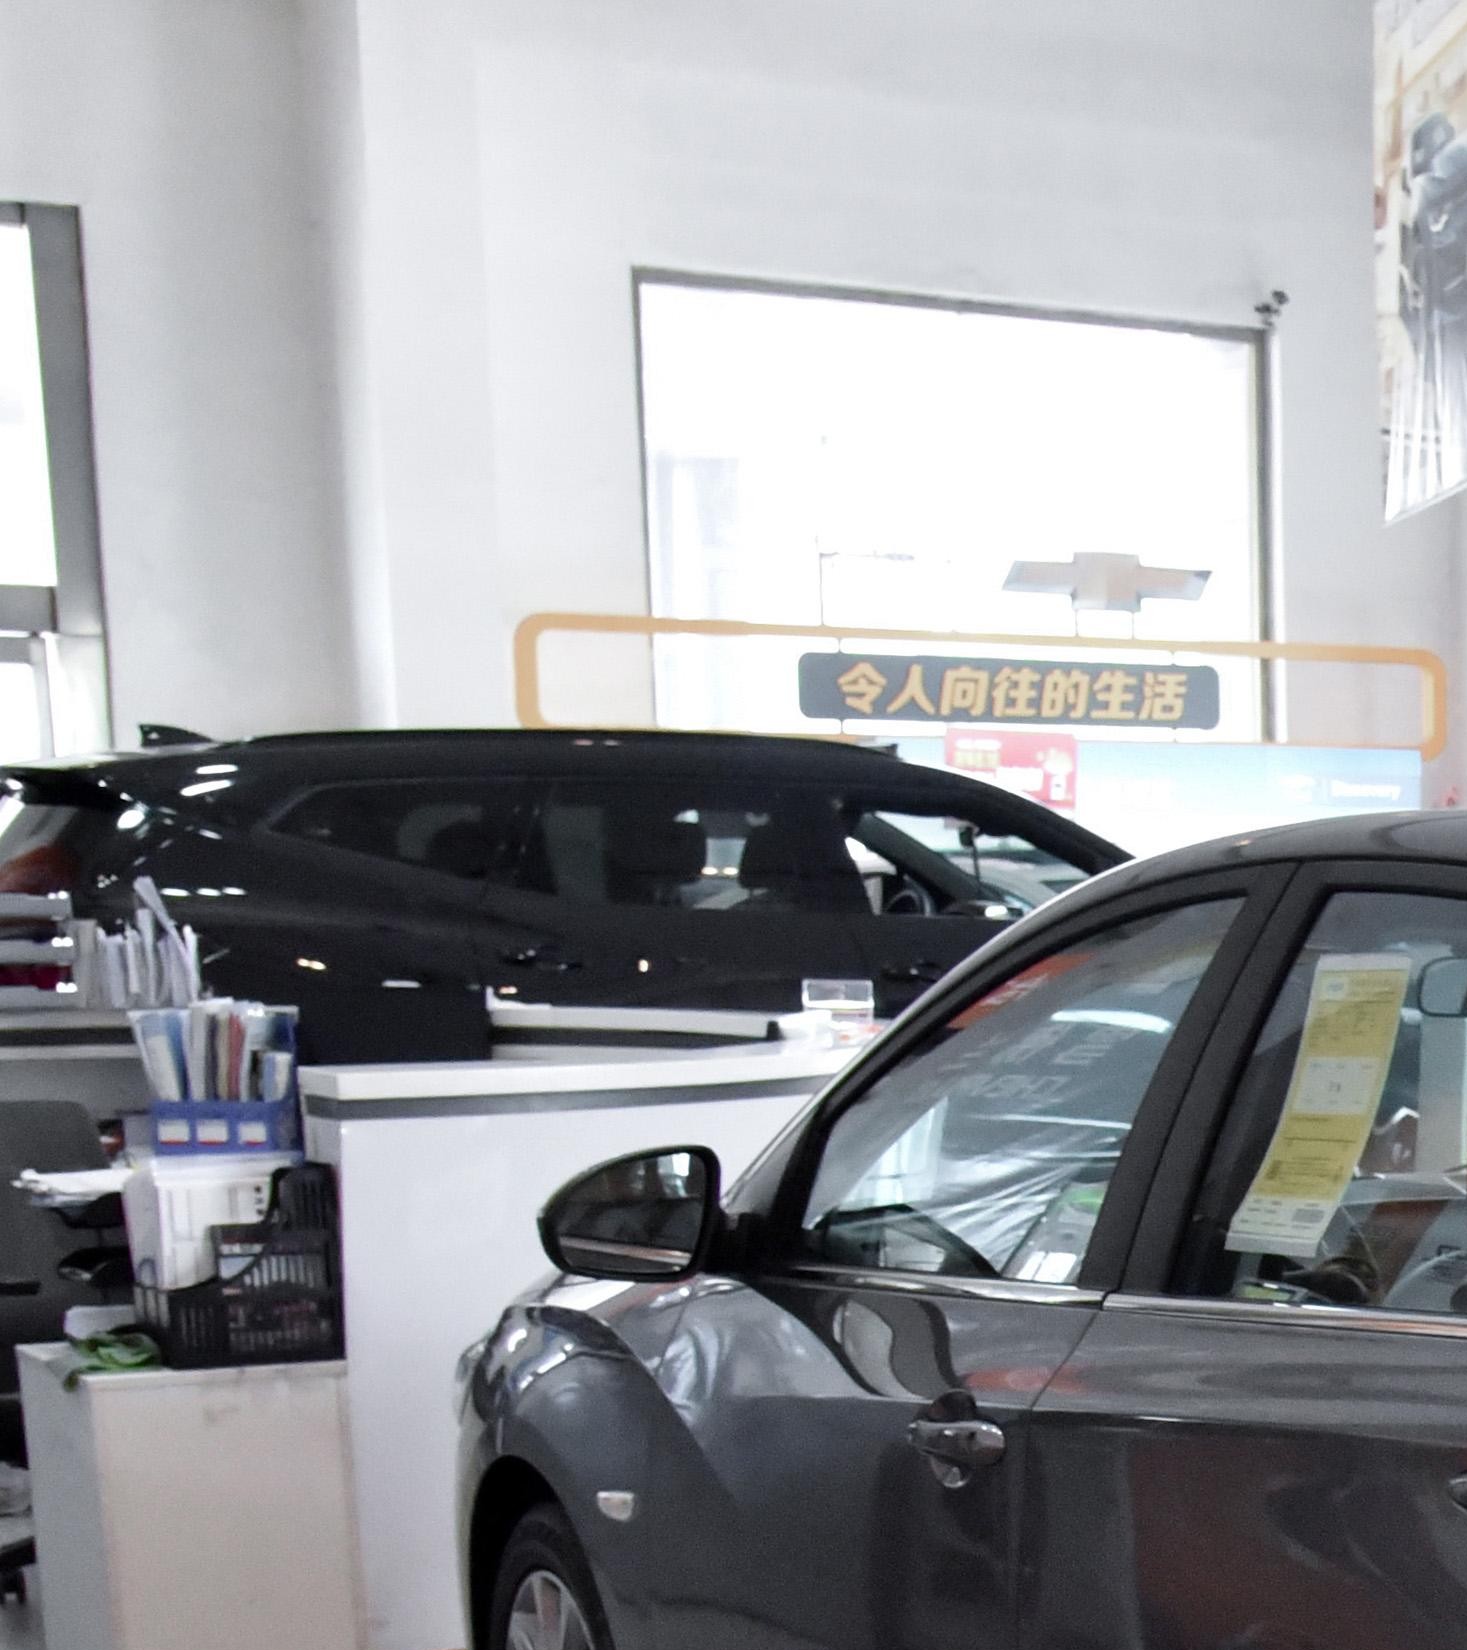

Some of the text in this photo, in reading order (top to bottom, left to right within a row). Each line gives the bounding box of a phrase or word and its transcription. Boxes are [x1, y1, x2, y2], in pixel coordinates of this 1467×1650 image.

[836, 661, 1188, 720] 令人向往的生活
